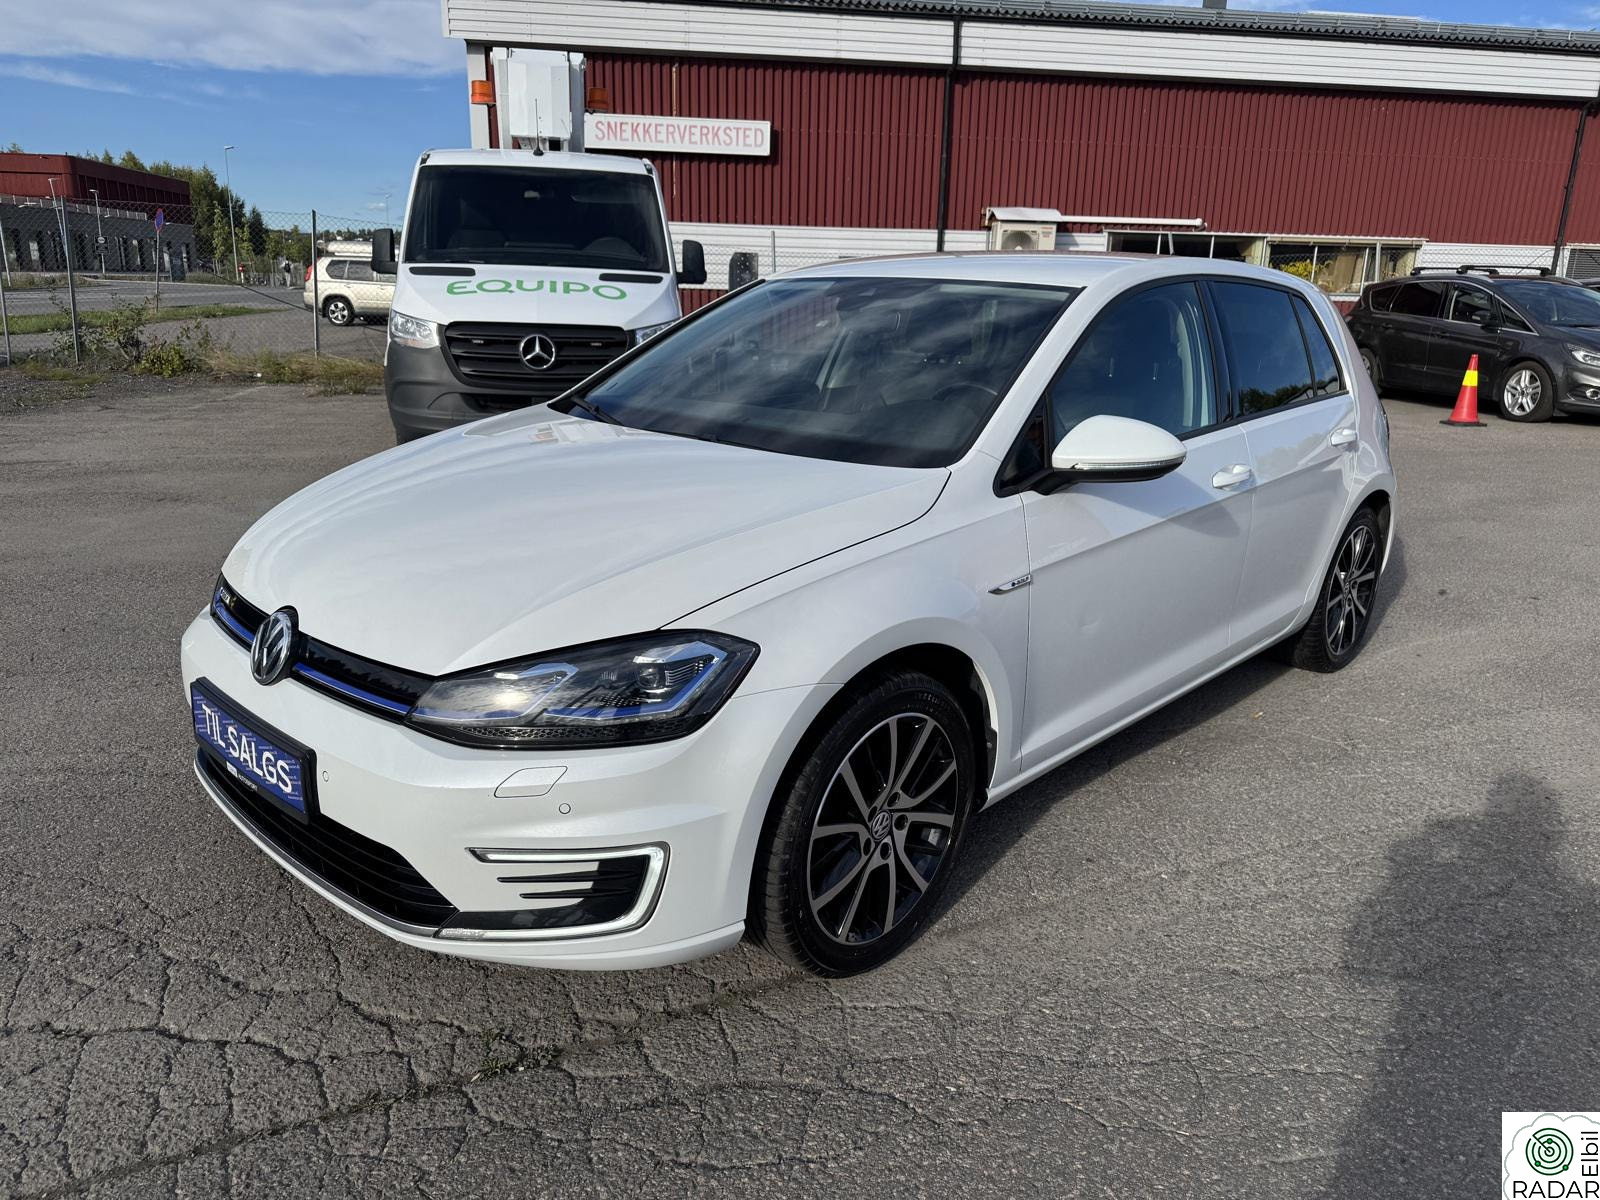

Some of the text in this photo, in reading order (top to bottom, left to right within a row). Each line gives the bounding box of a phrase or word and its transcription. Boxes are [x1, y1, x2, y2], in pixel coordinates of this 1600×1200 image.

[595, 120, 765, 148] SNEKKERVERKSTED
[446, 279, 628, 300] EQUIPO
[202, 704, 226, 748] TIL
[227, 726, 293, 793] SALGS
